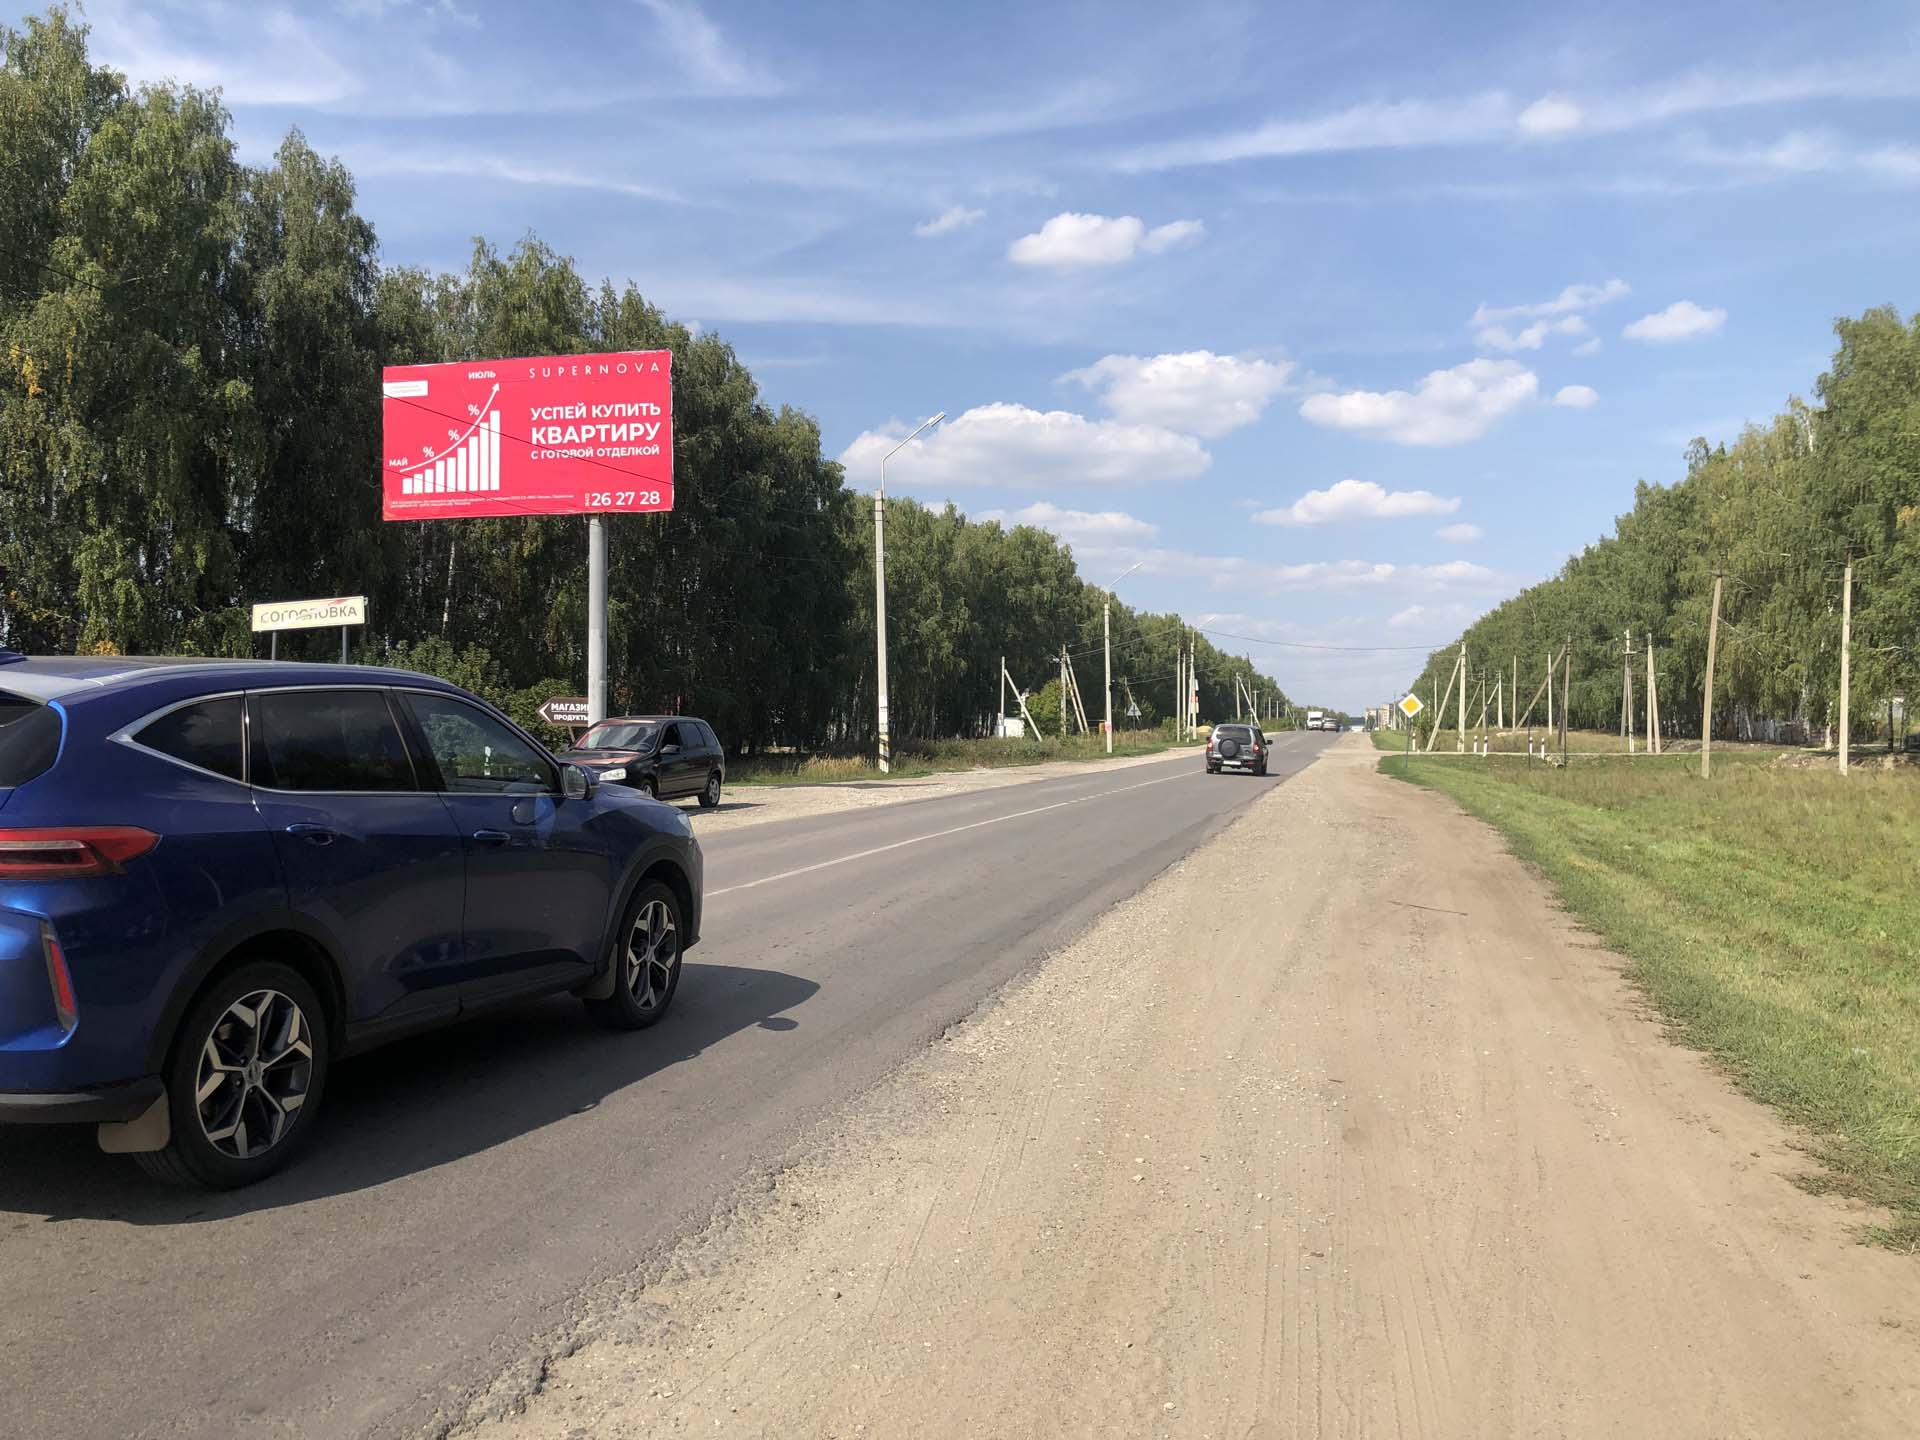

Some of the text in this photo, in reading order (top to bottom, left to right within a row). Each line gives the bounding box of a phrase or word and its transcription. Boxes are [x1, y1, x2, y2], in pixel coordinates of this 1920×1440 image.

[468, 370, 496, 380] ИЮЛЬ
[529, 362, 660, 378] SUPERNOVA
[468, 404, 480, 416] %
[530, 402, 661, 421] УСПЕЙ КУПИТЬ
[448, 429, 460, 441] %
[531, 422, 661, 445] КВАРТИРУ
[423, 446, 435, 458] %
[530, 445, 660, 460] С ГОТОВОЙ ОТДЕЛКОЙ
[389, 458, 408, 467] МАЙ
[591, 492, 612, 506] 26
[615, 491, 636, 506] 27
[640, 490, 661, 505] 28
